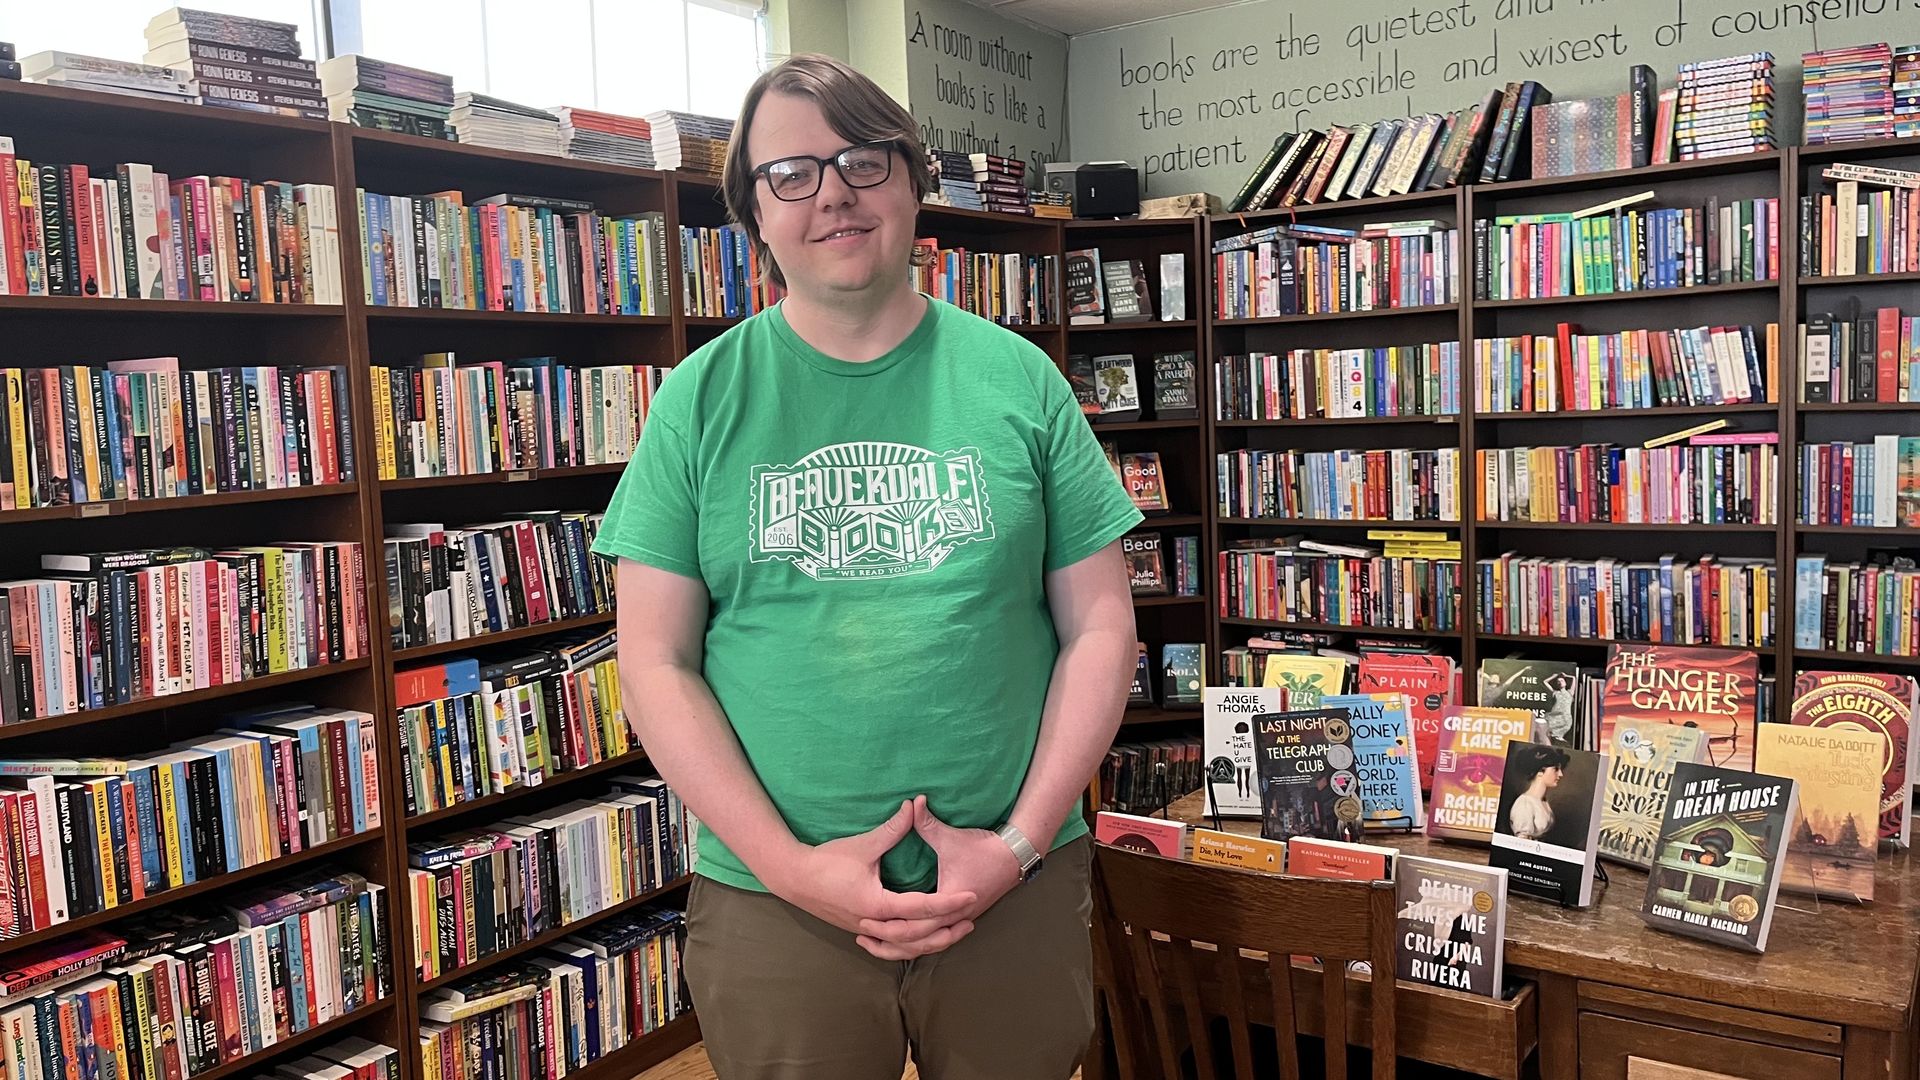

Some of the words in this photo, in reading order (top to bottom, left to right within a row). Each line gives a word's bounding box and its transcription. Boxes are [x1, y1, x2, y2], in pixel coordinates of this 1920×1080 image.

[909, 11, 928, 48] A
[933, 23, 972, 62] room
[979, 36, 1033, 81] without
[1120, 37, 1196, 87] books
[1212, 45, 1258, 72] are
[1275, 13, 1320, 60] the
[1346, 0, 1476, 61] quietest
[218, 48, 248, 63] GENESIS
[1138, 89, 1183, 130] the
[1197, 88, 1261, 122] most
[1272, 49, 1415, 109] accessible
[1444, 28, 1497, 82] and
[1519, 25, 1627, 68] wisest
[1655, 0, 1688, 46] of
[224, 68, 253, 83] GENESIS
[230, 87, 259, 102] GENESIS
[936, 64, 975, 110] books
[983, 85, 995, 115] is
[1003, 83, 1028, 124] like
[1037, 105, 1047, 130] a
[1145, 136, 1247, 192] patient
[42, 165, 62, 257] CONFESSIONS
[176, 245, 186, 281] WOMEN
[1111, 305, 1138, 314] SMILEY
[1114, 298, 1134, 306] JANE
[1095, 358, 1133, 371] HEARTWOOD
[222, 373, 232, 392] The
[319, 374, 330, 404] Sweet
[282, 376, 294, 416] FOURTEEN
[1119, 396, 1138, 408] GAIGE
[224, 393, 234, 420] Push
[1124, 464, 1157, 477] Good
[769, 459, 972, 523] BEAVERDALE
[1132, 480, 1153, 491] Dirt
[767, 533, 794, 546] 2006
[801, 504, 968, 557] BOOKS
[1123, 538, 1160, 552] Bear
[105, 555, 123, 563] WHEN
[124, 553, 147, 561] WOMEN
[120, 559, 149, 567] DRAGONS
[465, 572, 475, 591] MARK
[859, 568, 885, 577] READ
[1135, 570, 1154, 579] Julia
[1131, 578, 1160, 587] Phillips
[469, 592, 480, 622] DOTEN
[130, 600, 138, 644] BANVILLE
[1619, 651, 1657, 669] THE
[505, 675, 519, 688] TREES
[1166, 668, 1199, 677] ISOLA
[1522, 676, 1538, 685] THE
[1613, 665, 1743, 698] HUNGER
[1820, 674, 1837, 685] NINO
[1379, 676, 1428, 689] PLAIN
[1223, 695, 1260, 705] ANGIE
[1506, 691, 1547, 702] PHOEBE
[1631, 689, 1740, 716] GAMES
[1216, 704, 1266, 714] THOMAS
[1347, 705, 1384, 720] SALLY
[1806, 703, 1825, 719] THE
[1822, 694, 1897, 725] EIGHTH
[1259, 718, 1288, 734] LAST
[1291, 716, 1328, 731] NIGHT
[1443, 716, 1526, 736] CREATION
[1276, 736, 1286, 745] AT
[1287, 735, 1301, 744] THE
[1461, 734, 1502, 750] LAKE
[1778, 734, 1827, 749] NATALIE
[1828, 738, 1877, 754] BABBITT
[1266, 743, 1332, 760] TELEGRAPH
[1354, 753, 1405, 767] AUTIFUL
[1295, 760, 1325, 774] CLUB
[1362, 783, 1398, 797] HERE
[1684, 782, 1699, 798] IN
[1700, 778, 1720, 795] THE
[1373, 799, 1404, 812] YOU
[1444, 793, 1499, 813] RACHE
[1672, 792, 1727, 821] DREAM
[1728, 785, 1782, 811] HOUSE
[59, 790, 73, 845] BEAUTYLAND
[126, 791, 136, 835] NEVADA
[1434, 808, 1497, 828] KUSHN
[167, 815, 176, 843] Summer
[1598, 827, 1653, 859] matri
[170, 845, 178, 870] Sisters
[1213, 848, 1226, 859] My
[1228, 850, 1243, 861] Love
[1301, 849, 1331, 860] NATIONAL
[1333, 854, 1371, 865] BESTSELLER
[1519, 860, 1532, 868] JANE
[1532, 864, 1553, 873] AUSTEN
[1421, 878, 1474, 905] DEATH
[1534, 877, 1561, 888] SENSIBILITY
[464, 877, 473, 910] FAVORITES
[439, 908, 447, 927] DIES
[1405, 900, 1455, 928] TAKES
[1460, 912, 1487, 935] ME
[1652, 904, 1682, 923] CARMEN
[1683, 909, 1709, 928] MARIA
[1710, 914, 1749, 936] MACHADO
[351, 919, 361, 961] WATERS
[440, 929, 450, 957] ALONE
[1404, 931, 1483, 966] CRISTINA
[9, 980, 30, 994] DEEP
[32, 972, 54, 987] CUTS
[58, 961, 83, 976] HOLLY
[85, 948, 121, 967] BRICKLEY
[1411, 958, 1472, 990] RIVERA
[196, 966, 212, 1007] BURKE
[535, 990, 545, 1048] MASQUERADE
[203, 1020, 218, 1052] CLETE
